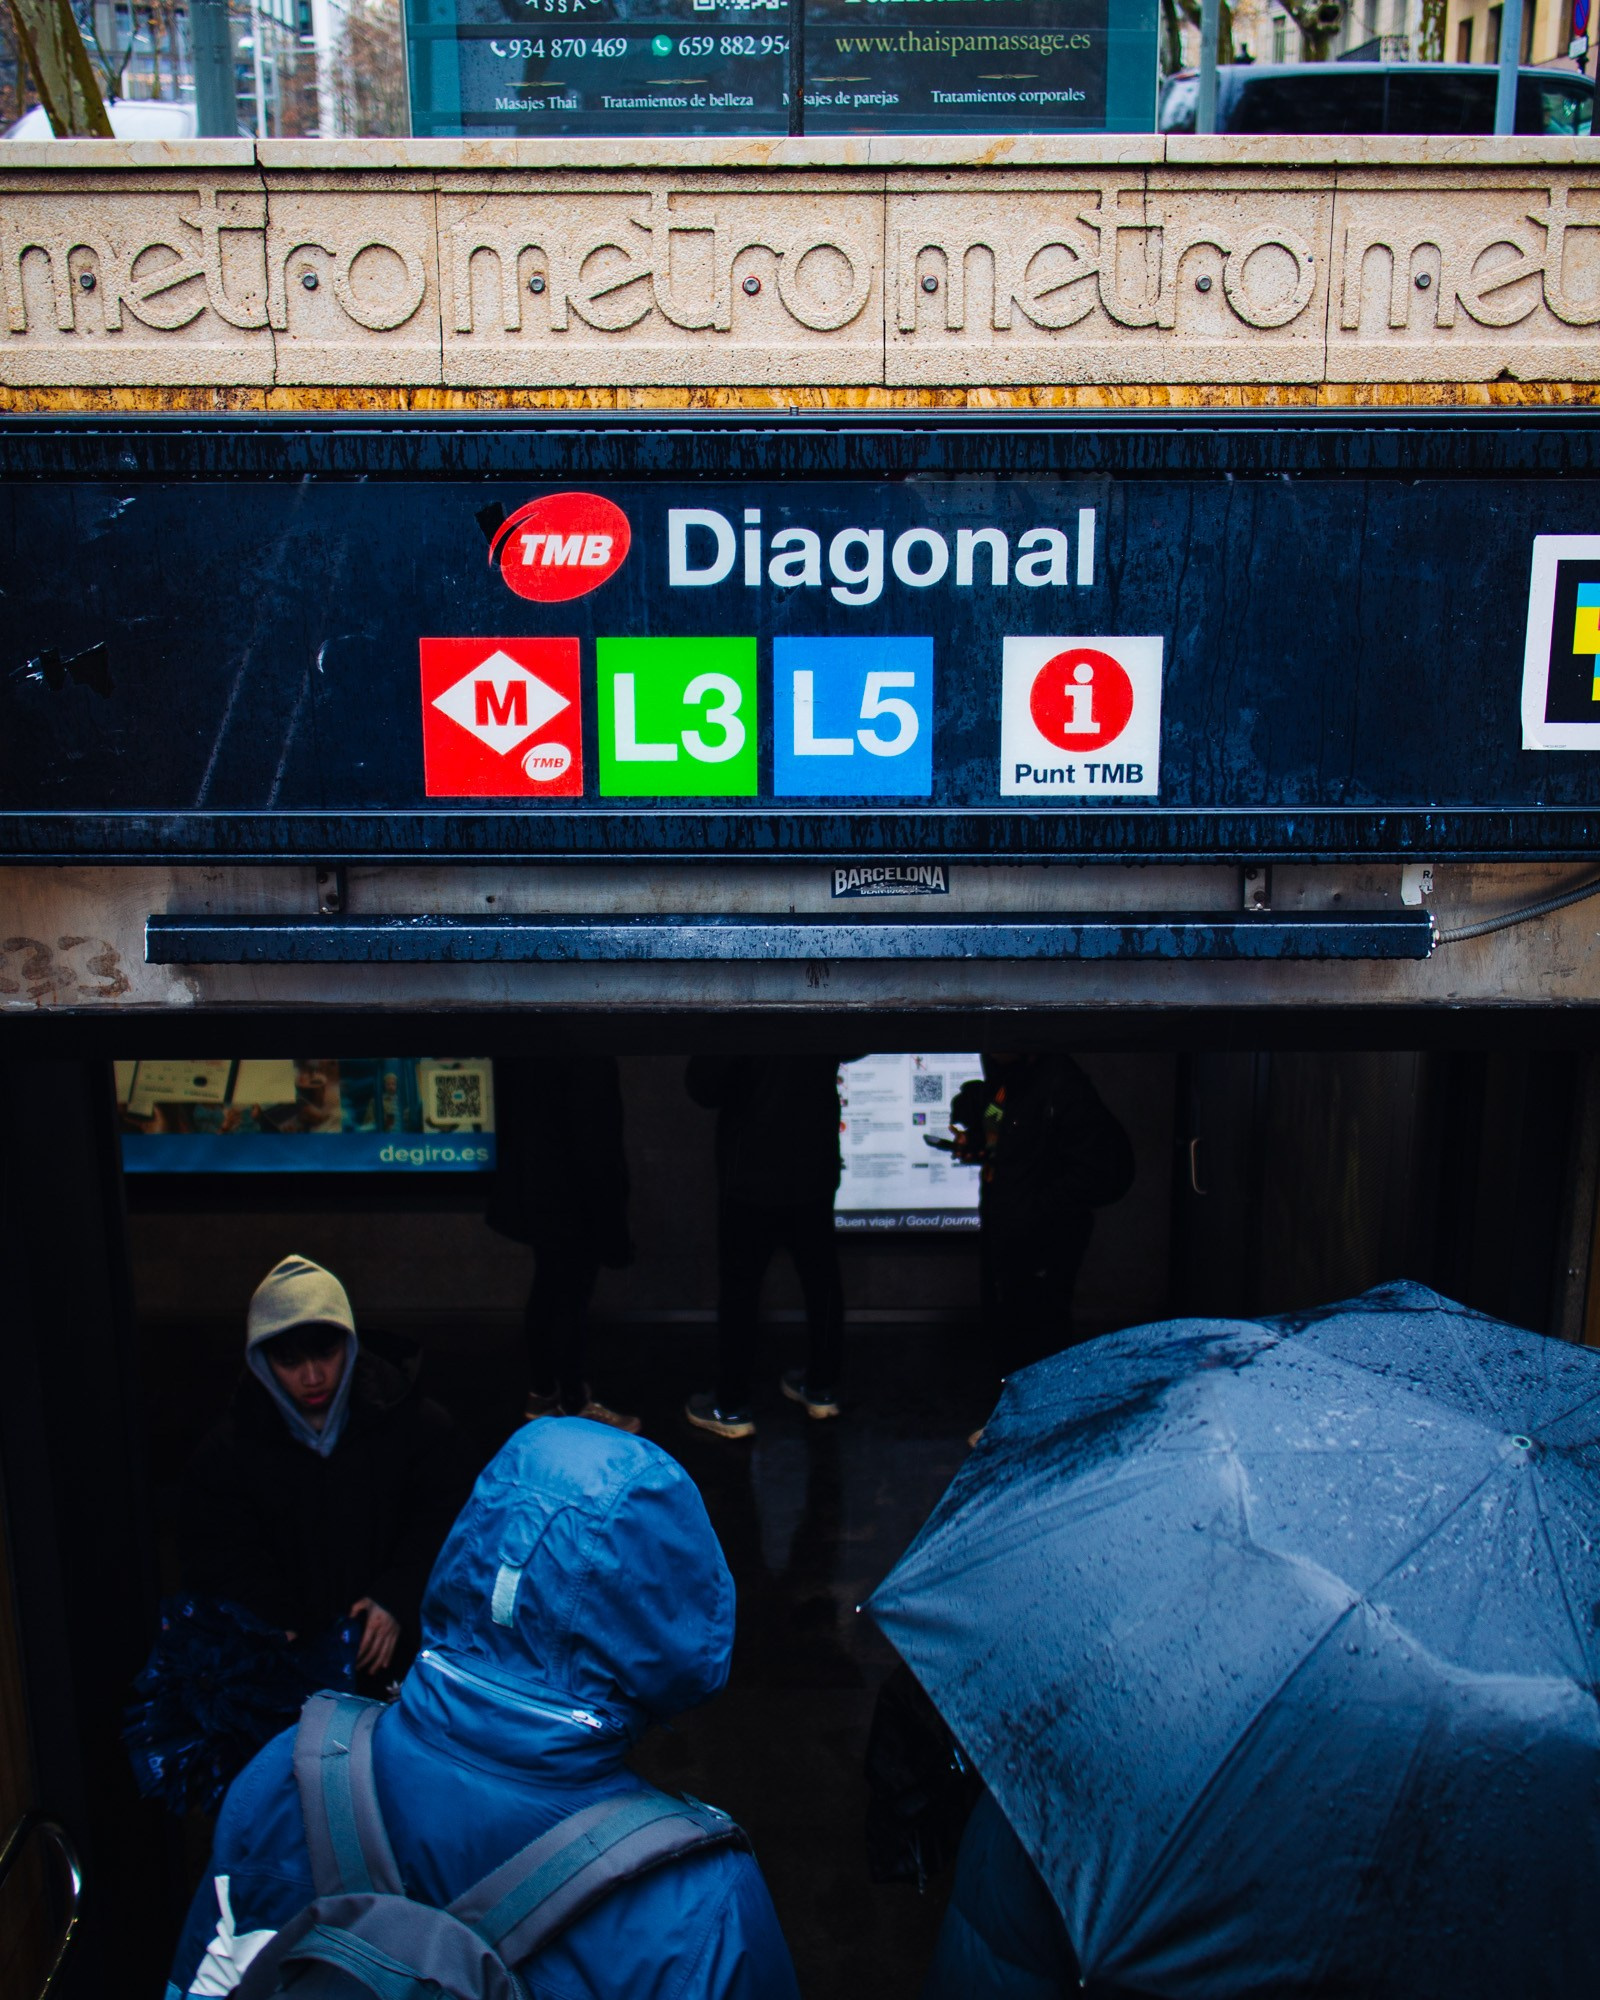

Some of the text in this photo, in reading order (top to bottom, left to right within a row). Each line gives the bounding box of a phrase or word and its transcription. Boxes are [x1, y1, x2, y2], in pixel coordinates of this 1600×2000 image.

[509, 37, 627, 58] 934 870 469
[678, 36, 714, 56] 659
[719, 35, 756, 55] 882
[835, 30, 1091, 57] www.thaispamassage.es
[495, 95, 578, 112] Masajes Thai
[601, 93, 754, 109] Tratamientos de belleza
[782, 90, 900, 107] Msajes de parejas
[931, 88, 1086, 105] Tratamientos corporales
[2, 190, 427, 332] metro
[452, 190, 871, 332] metro
[899, 189, 1316, 331] metro
[520, 507, 1096, 606] TMB Diagonal
[474, 679, 528, 727] M
[793, 670, 919, 757] L5
[613, 672, 746, 763] L3
[532, 757, 565, 769] TMB
[1015, 763, 1144, 784] Punt TMB
[834, 866, 946, 896] BARCELONA
[379, 1144, 490, 1167] degiro.es
[834, 1216, 866, 1228] Buen
[869, 1216, 895, 1228] viaje
[906, 1215, 940, 1226] Good
[941, 1215, 981, 1228] journe
